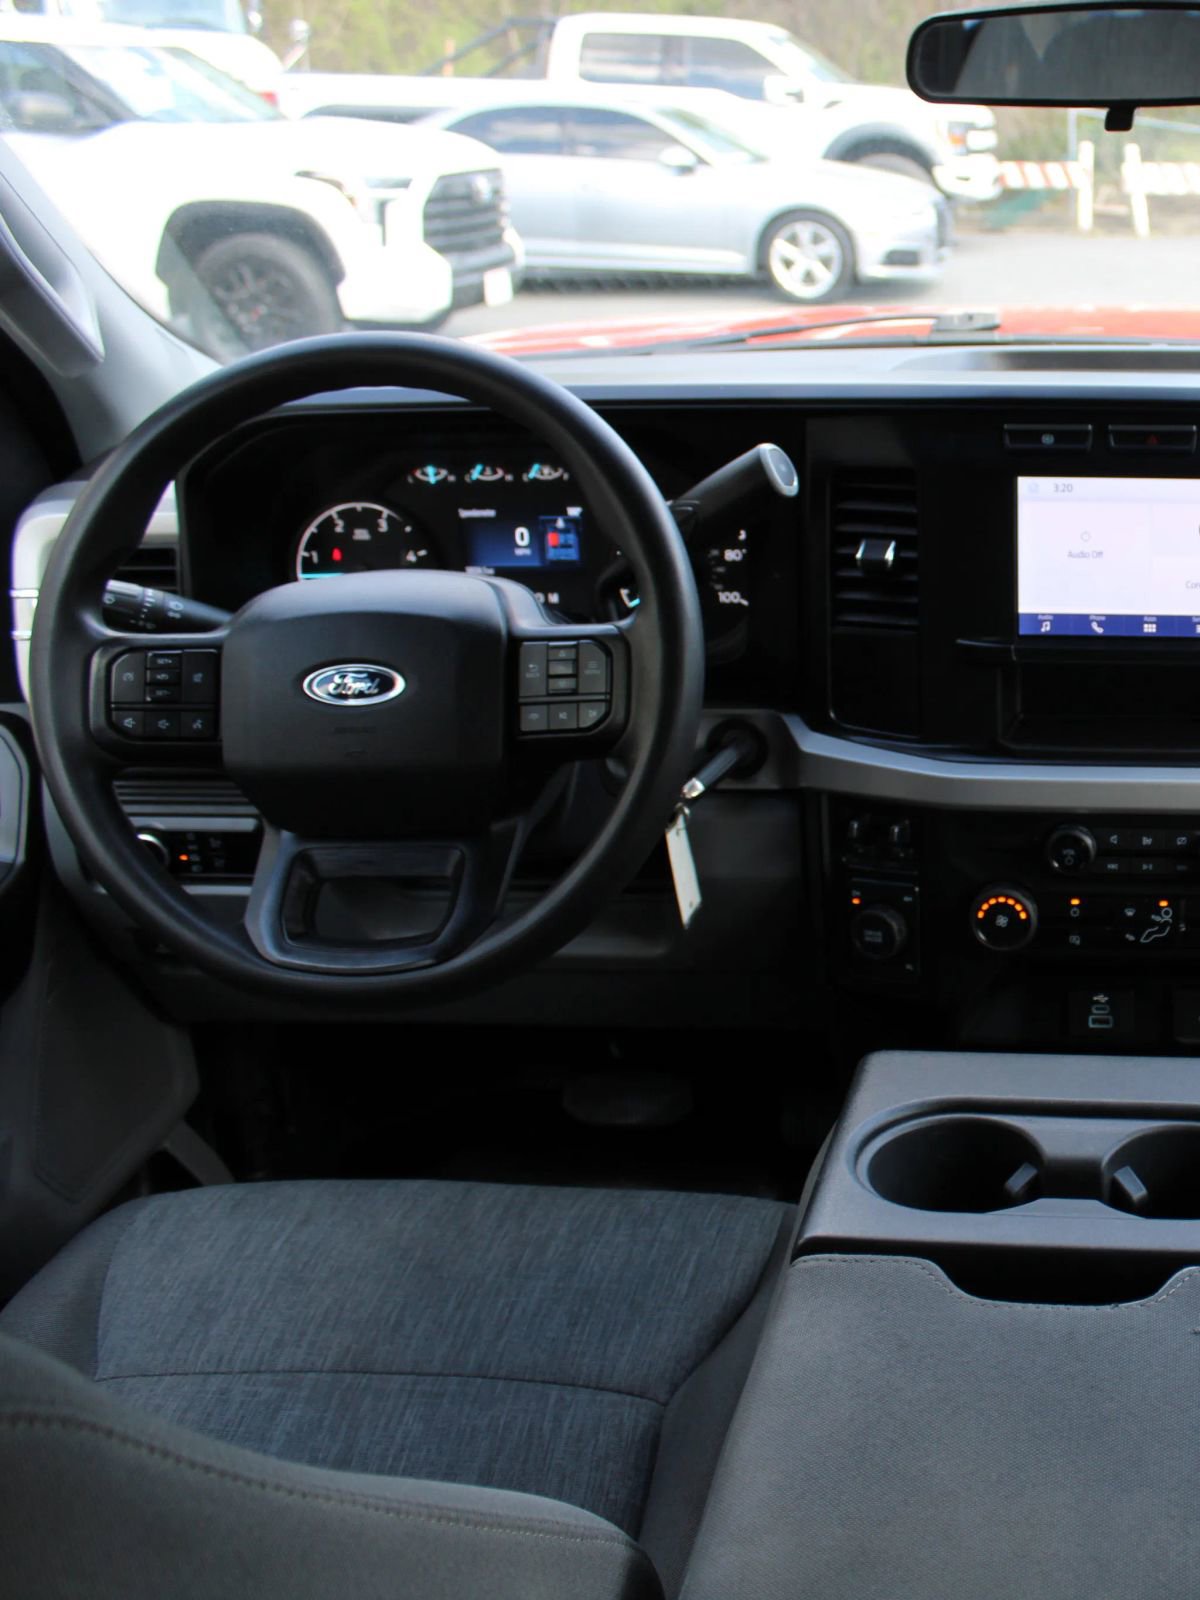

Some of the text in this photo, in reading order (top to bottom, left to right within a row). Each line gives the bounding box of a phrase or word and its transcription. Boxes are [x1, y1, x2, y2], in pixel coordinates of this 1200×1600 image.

[1053, 483, 1074, 493] 3:20
[334, 519, 345, 533] 2
[377, 518, 389, 533] 3
[514, 526, 531, 547] 0
[309, 551, 318, 564] 1
[406, 550, 417, 563] 4
[1067, 549, 1090, 559] Audio
[718, 590, 741, 604] 100
[326, 671, 381, 695] Ford
